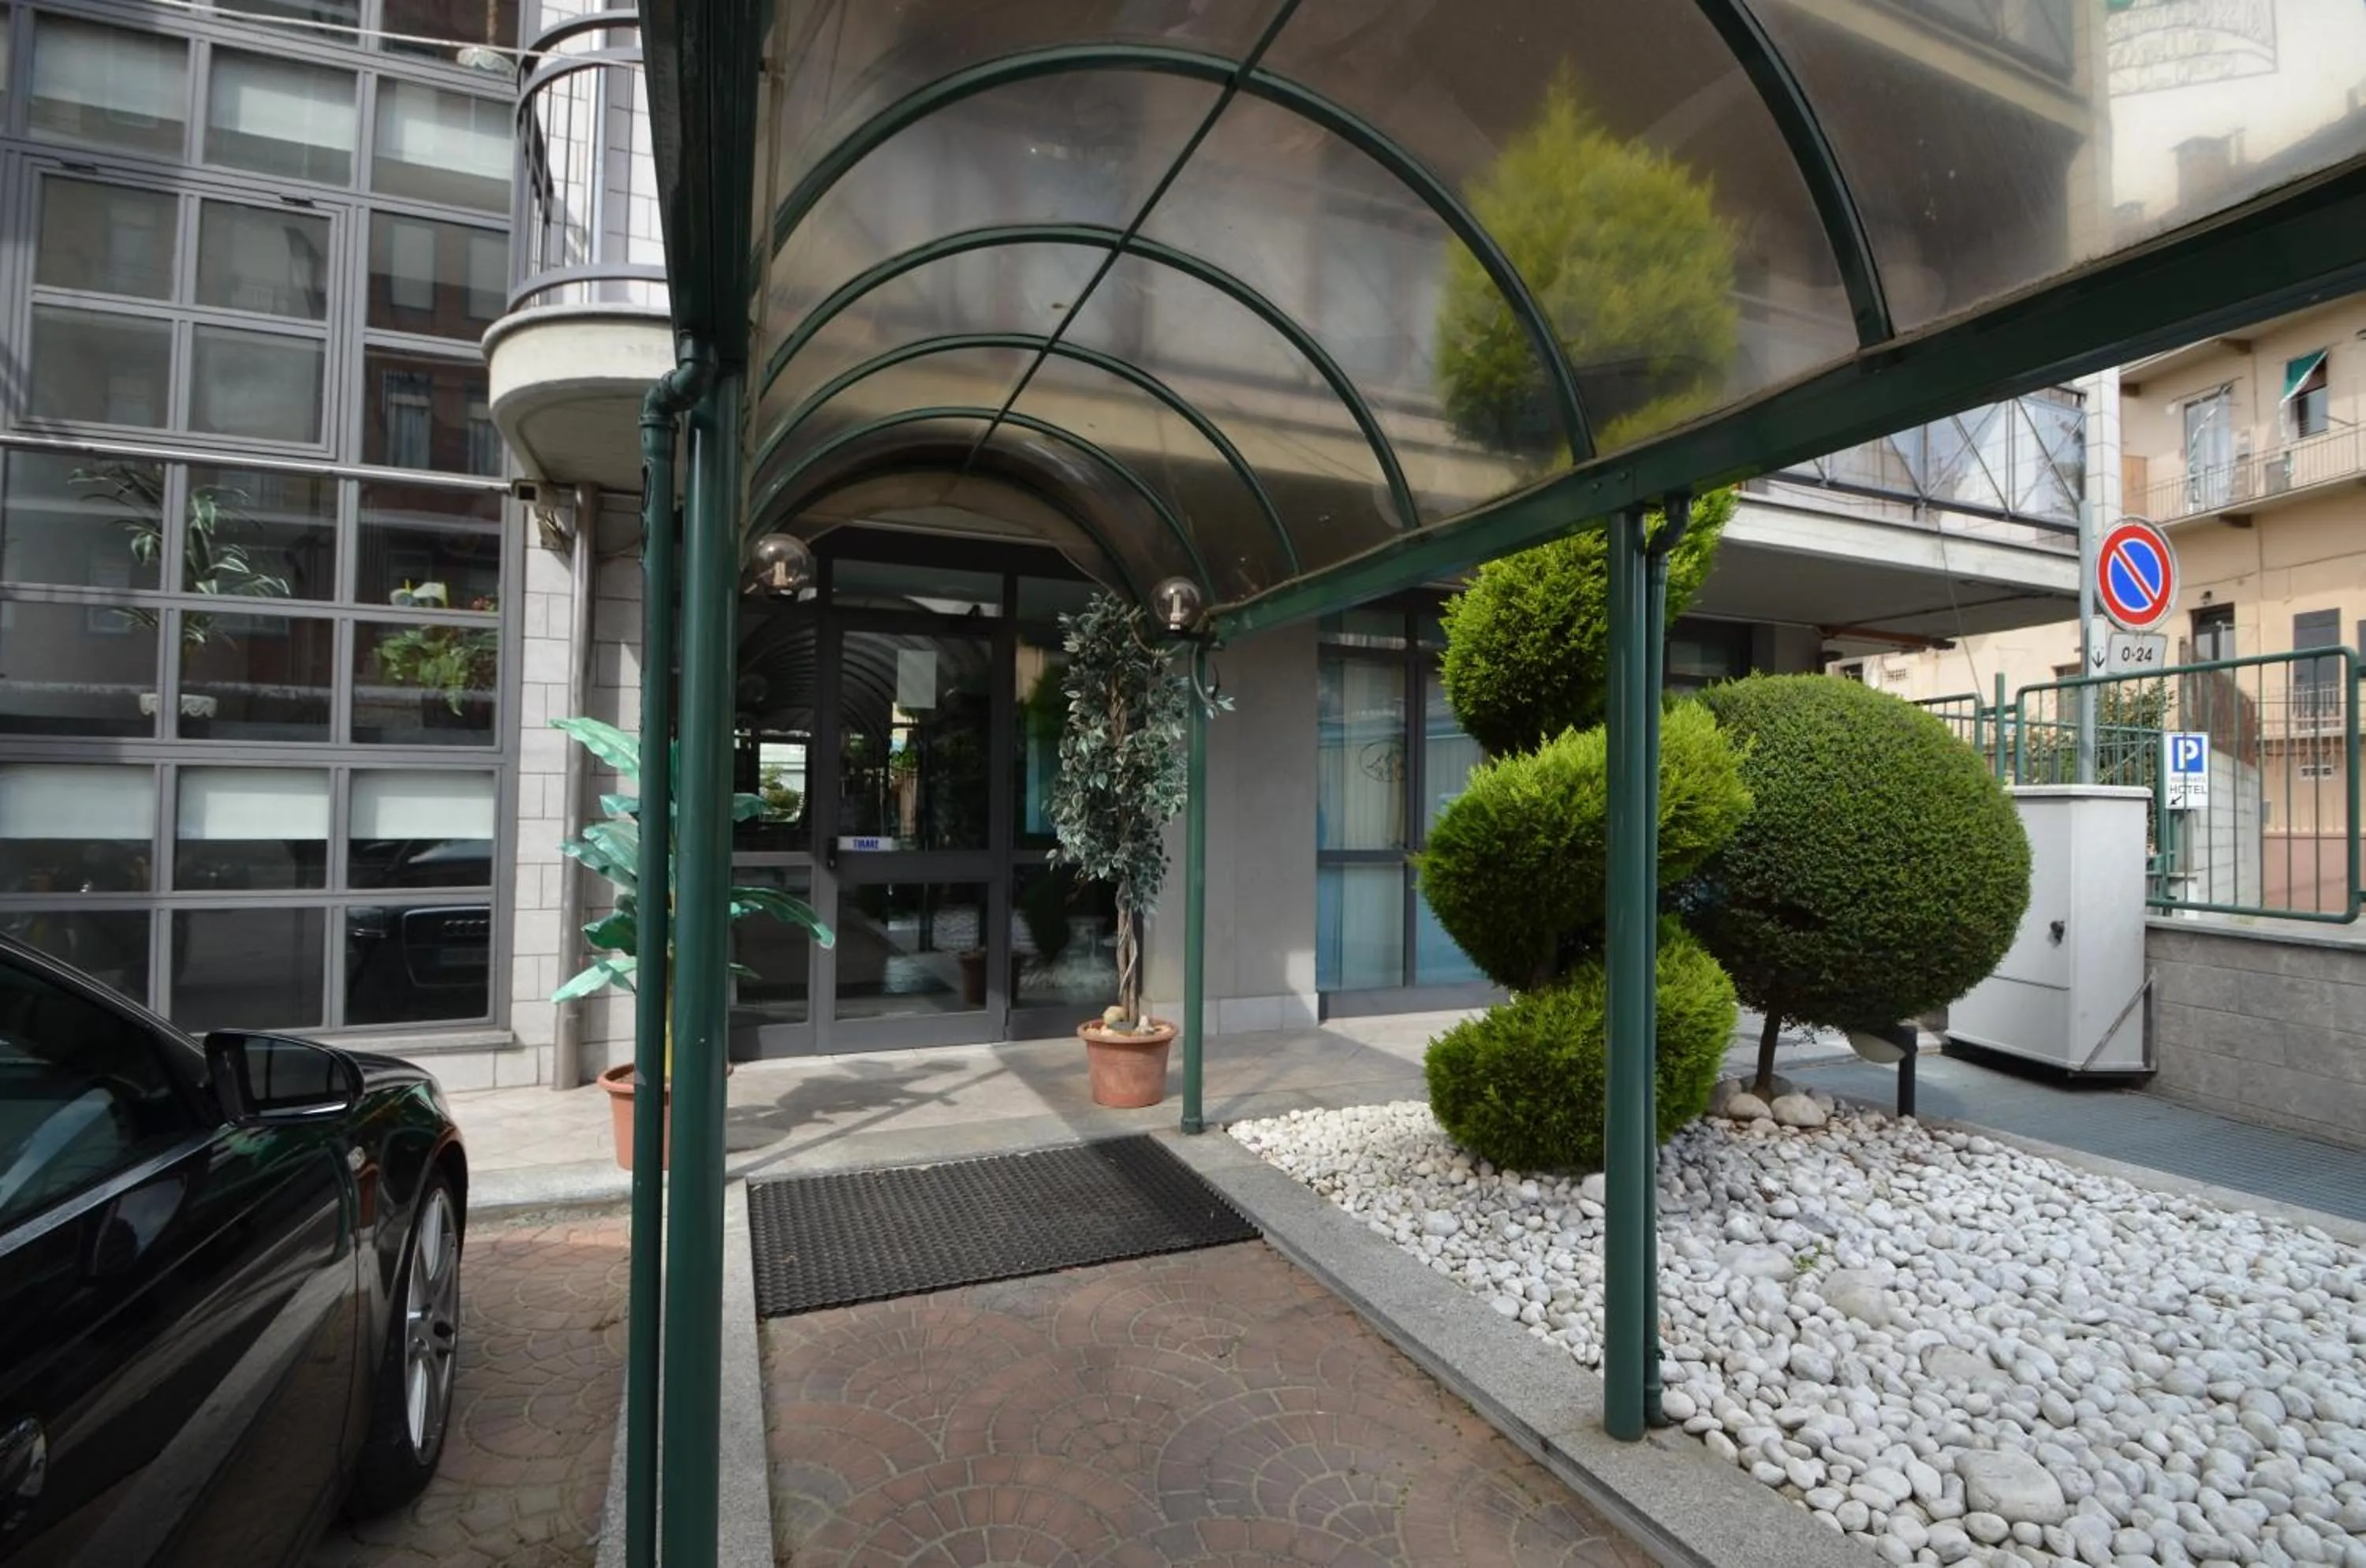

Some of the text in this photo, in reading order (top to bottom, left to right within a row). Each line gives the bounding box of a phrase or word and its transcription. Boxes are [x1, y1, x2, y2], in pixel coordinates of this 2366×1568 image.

[2122, 646, 2152, 662] 0-24
[2178, 739, 2199, 770] P
[2170, 785, 2208, 794] HOTEL
